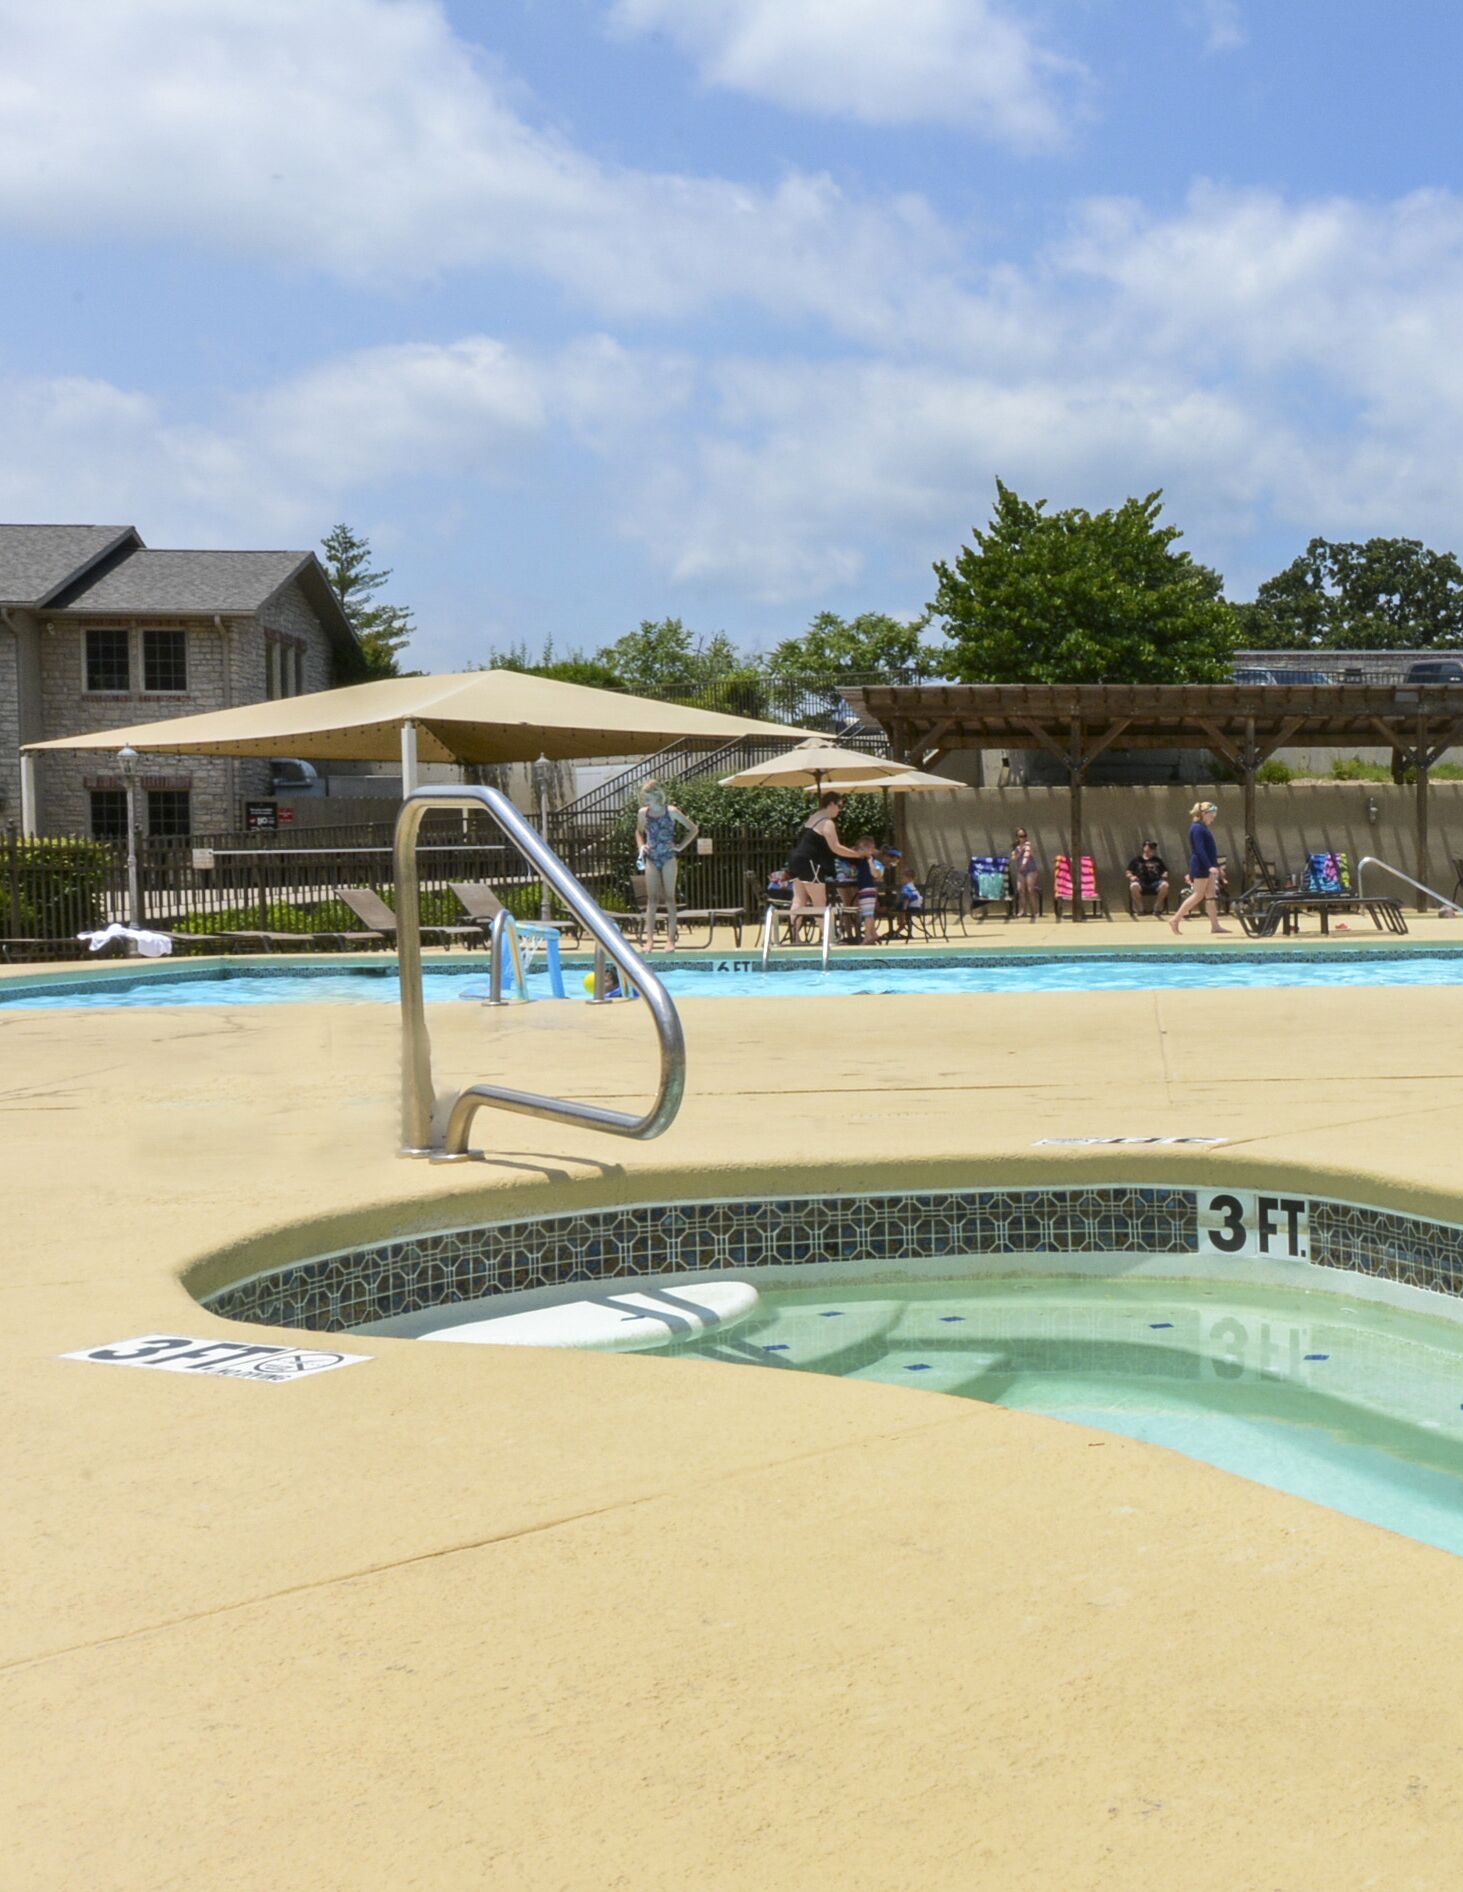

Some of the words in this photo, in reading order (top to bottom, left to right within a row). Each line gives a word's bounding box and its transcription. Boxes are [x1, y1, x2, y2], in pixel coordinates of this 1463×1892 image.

[1208, 1195, 1247, 1252] 3
[1258, 1196, 1307, 1258] FT.
[88, 1338, 193, 1361] 3
